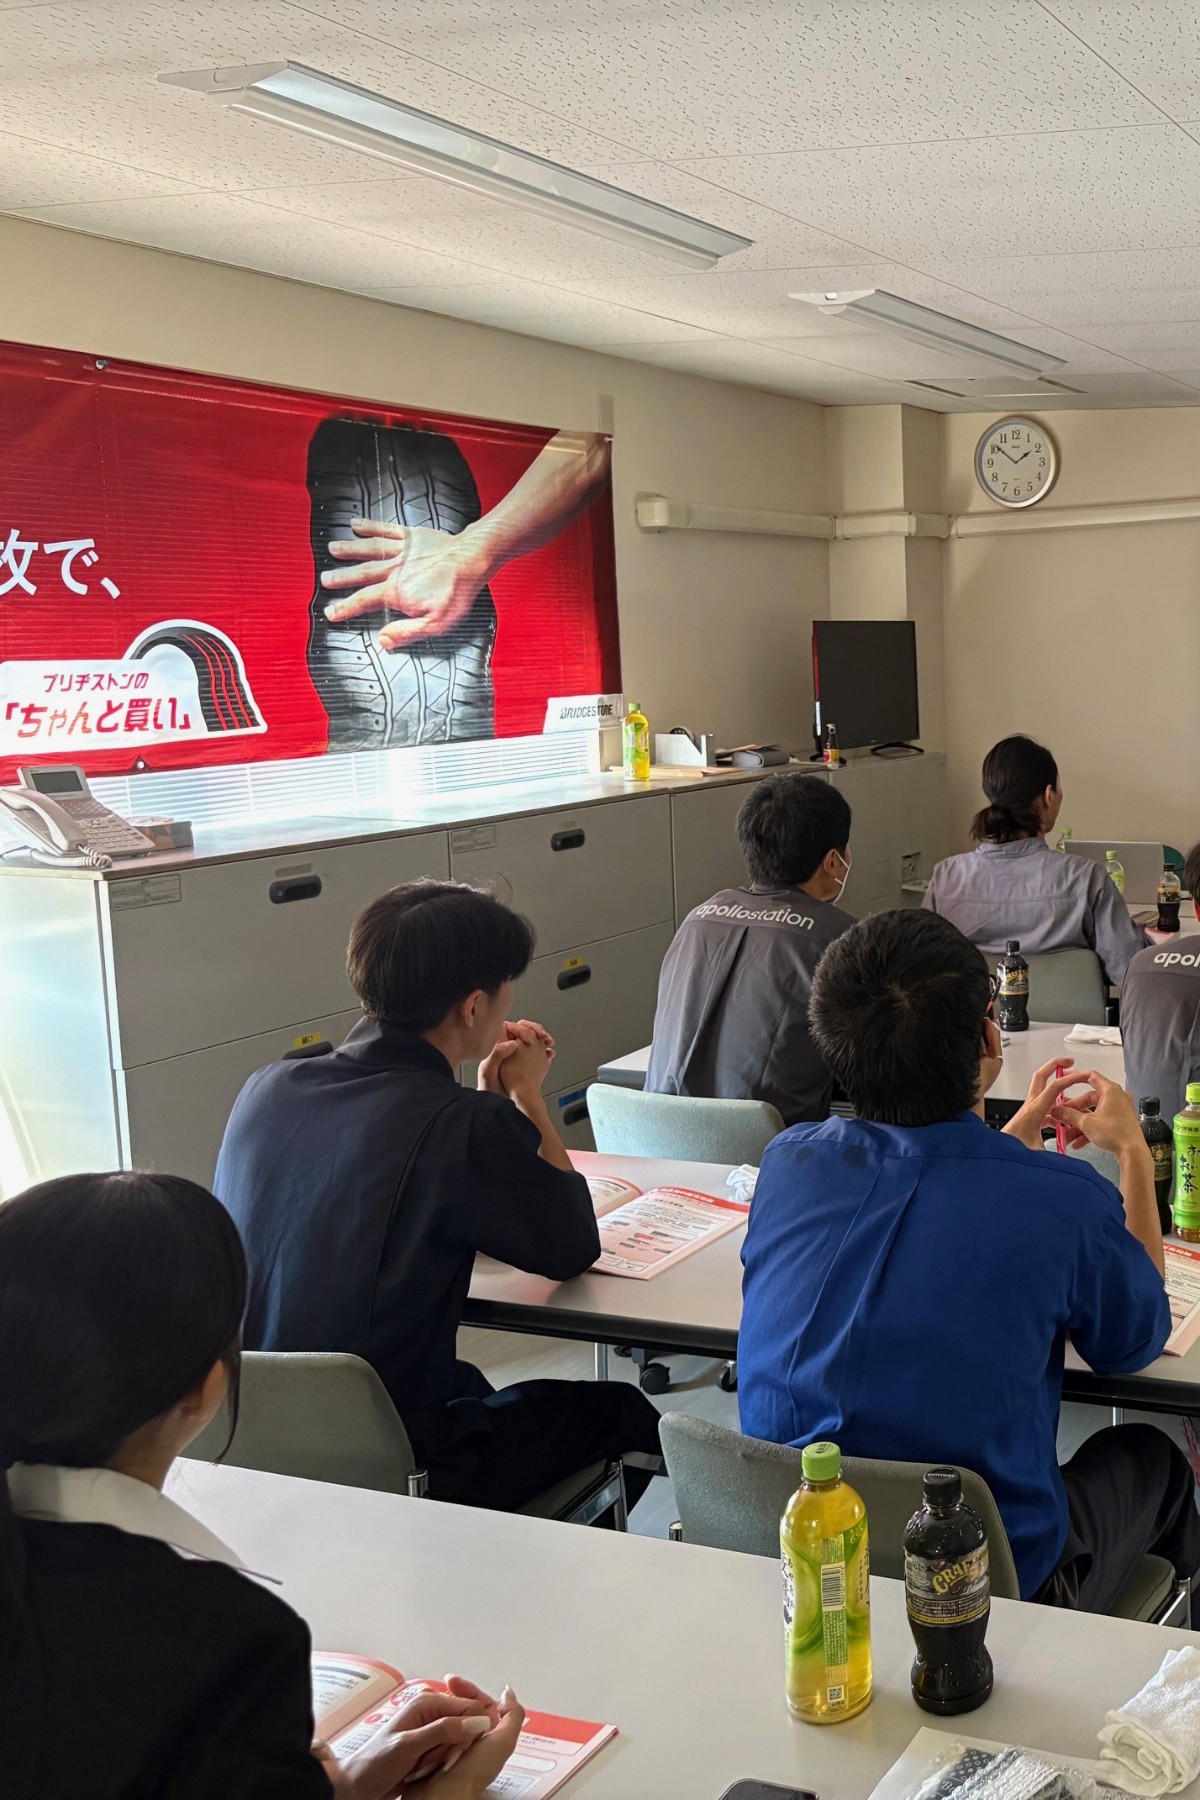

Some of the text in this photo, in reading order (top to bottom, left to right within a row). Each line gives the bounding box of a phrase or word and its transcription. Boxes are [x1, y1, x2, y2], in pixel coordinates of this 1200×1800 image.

[1000, 434, 1007, 443] 11
[1012, 430, 1020, 440] 12
[1035, 443, 1041, 453] 2
[987, 459, 994, 468] 9
[1039, 457, 1046, 467] 3
[992, 472, 998, 482] 8
[1002, 482, 1008, 492] 7
[1014, 486, 1020, 496] 6
[1027, 482, 1033, 492] 5
[43, 672, 150, 693] ブリヂストンの
[560, 703, 614, 720] BRIDGESTONE
[5, 697, 192, 738] 「ちゃんと買い」
[696, 904, 815, 930] apollostation
[932, 1552, 984, 1594] CRAF
